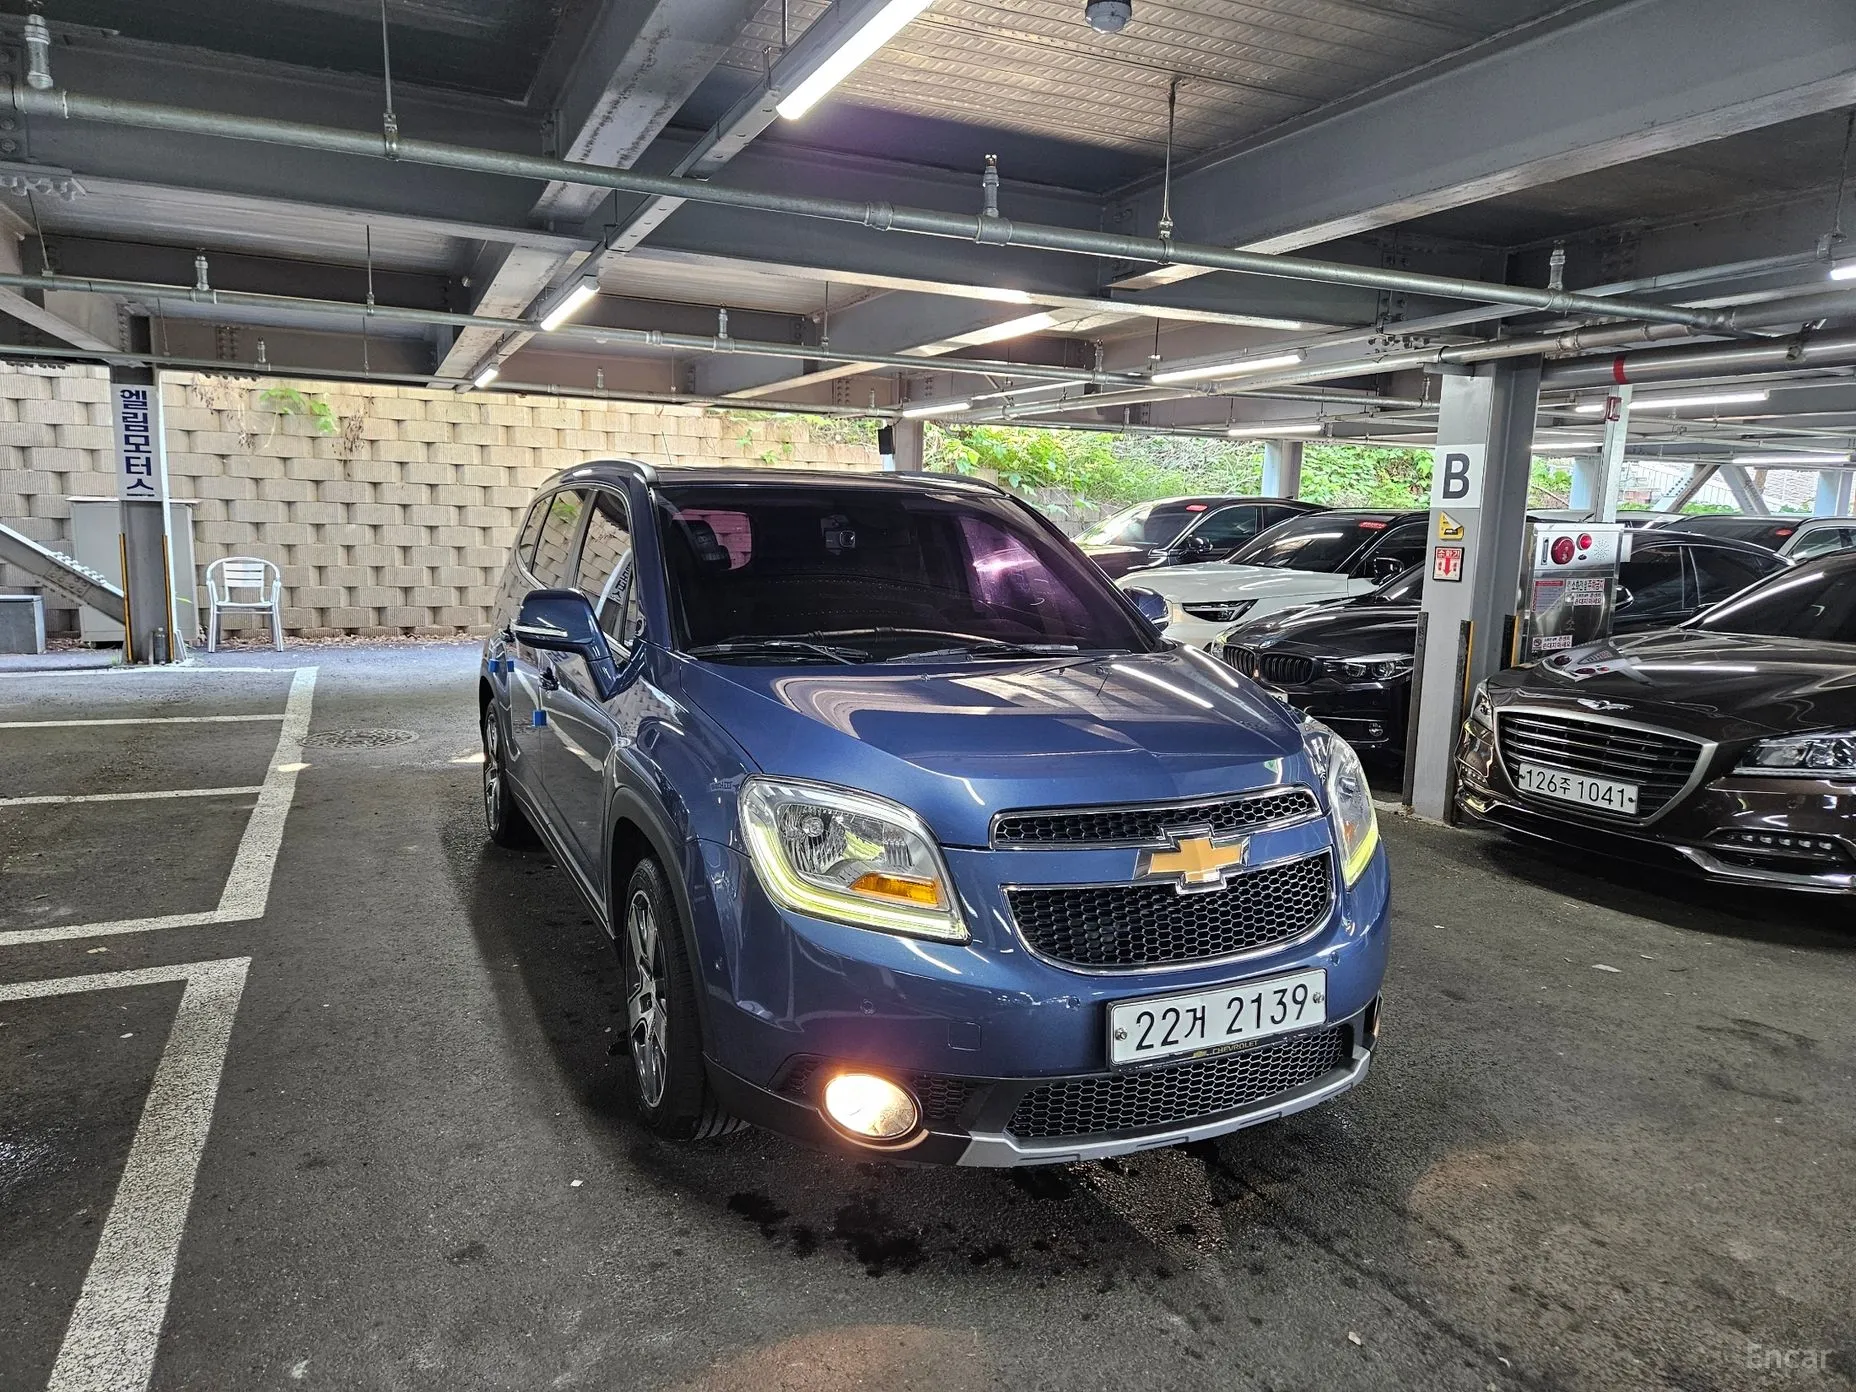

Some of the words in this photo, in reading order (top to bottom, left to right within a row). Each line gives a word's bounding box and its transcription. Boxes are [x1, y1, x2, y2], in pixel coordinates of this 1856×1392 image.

[120, 389, 155, 497] 엘림모터스
[1442, 453, 1470, 499] B
[1526, 769, 1572, 795] 126주
[1577, 780, 1626, 808] 1041
[1135, 1005, 1206, 1051] 22거
[1226, 983, 1309, 1035] 2139
[1212, 1040, 1258, 1055] CHEVROLET
